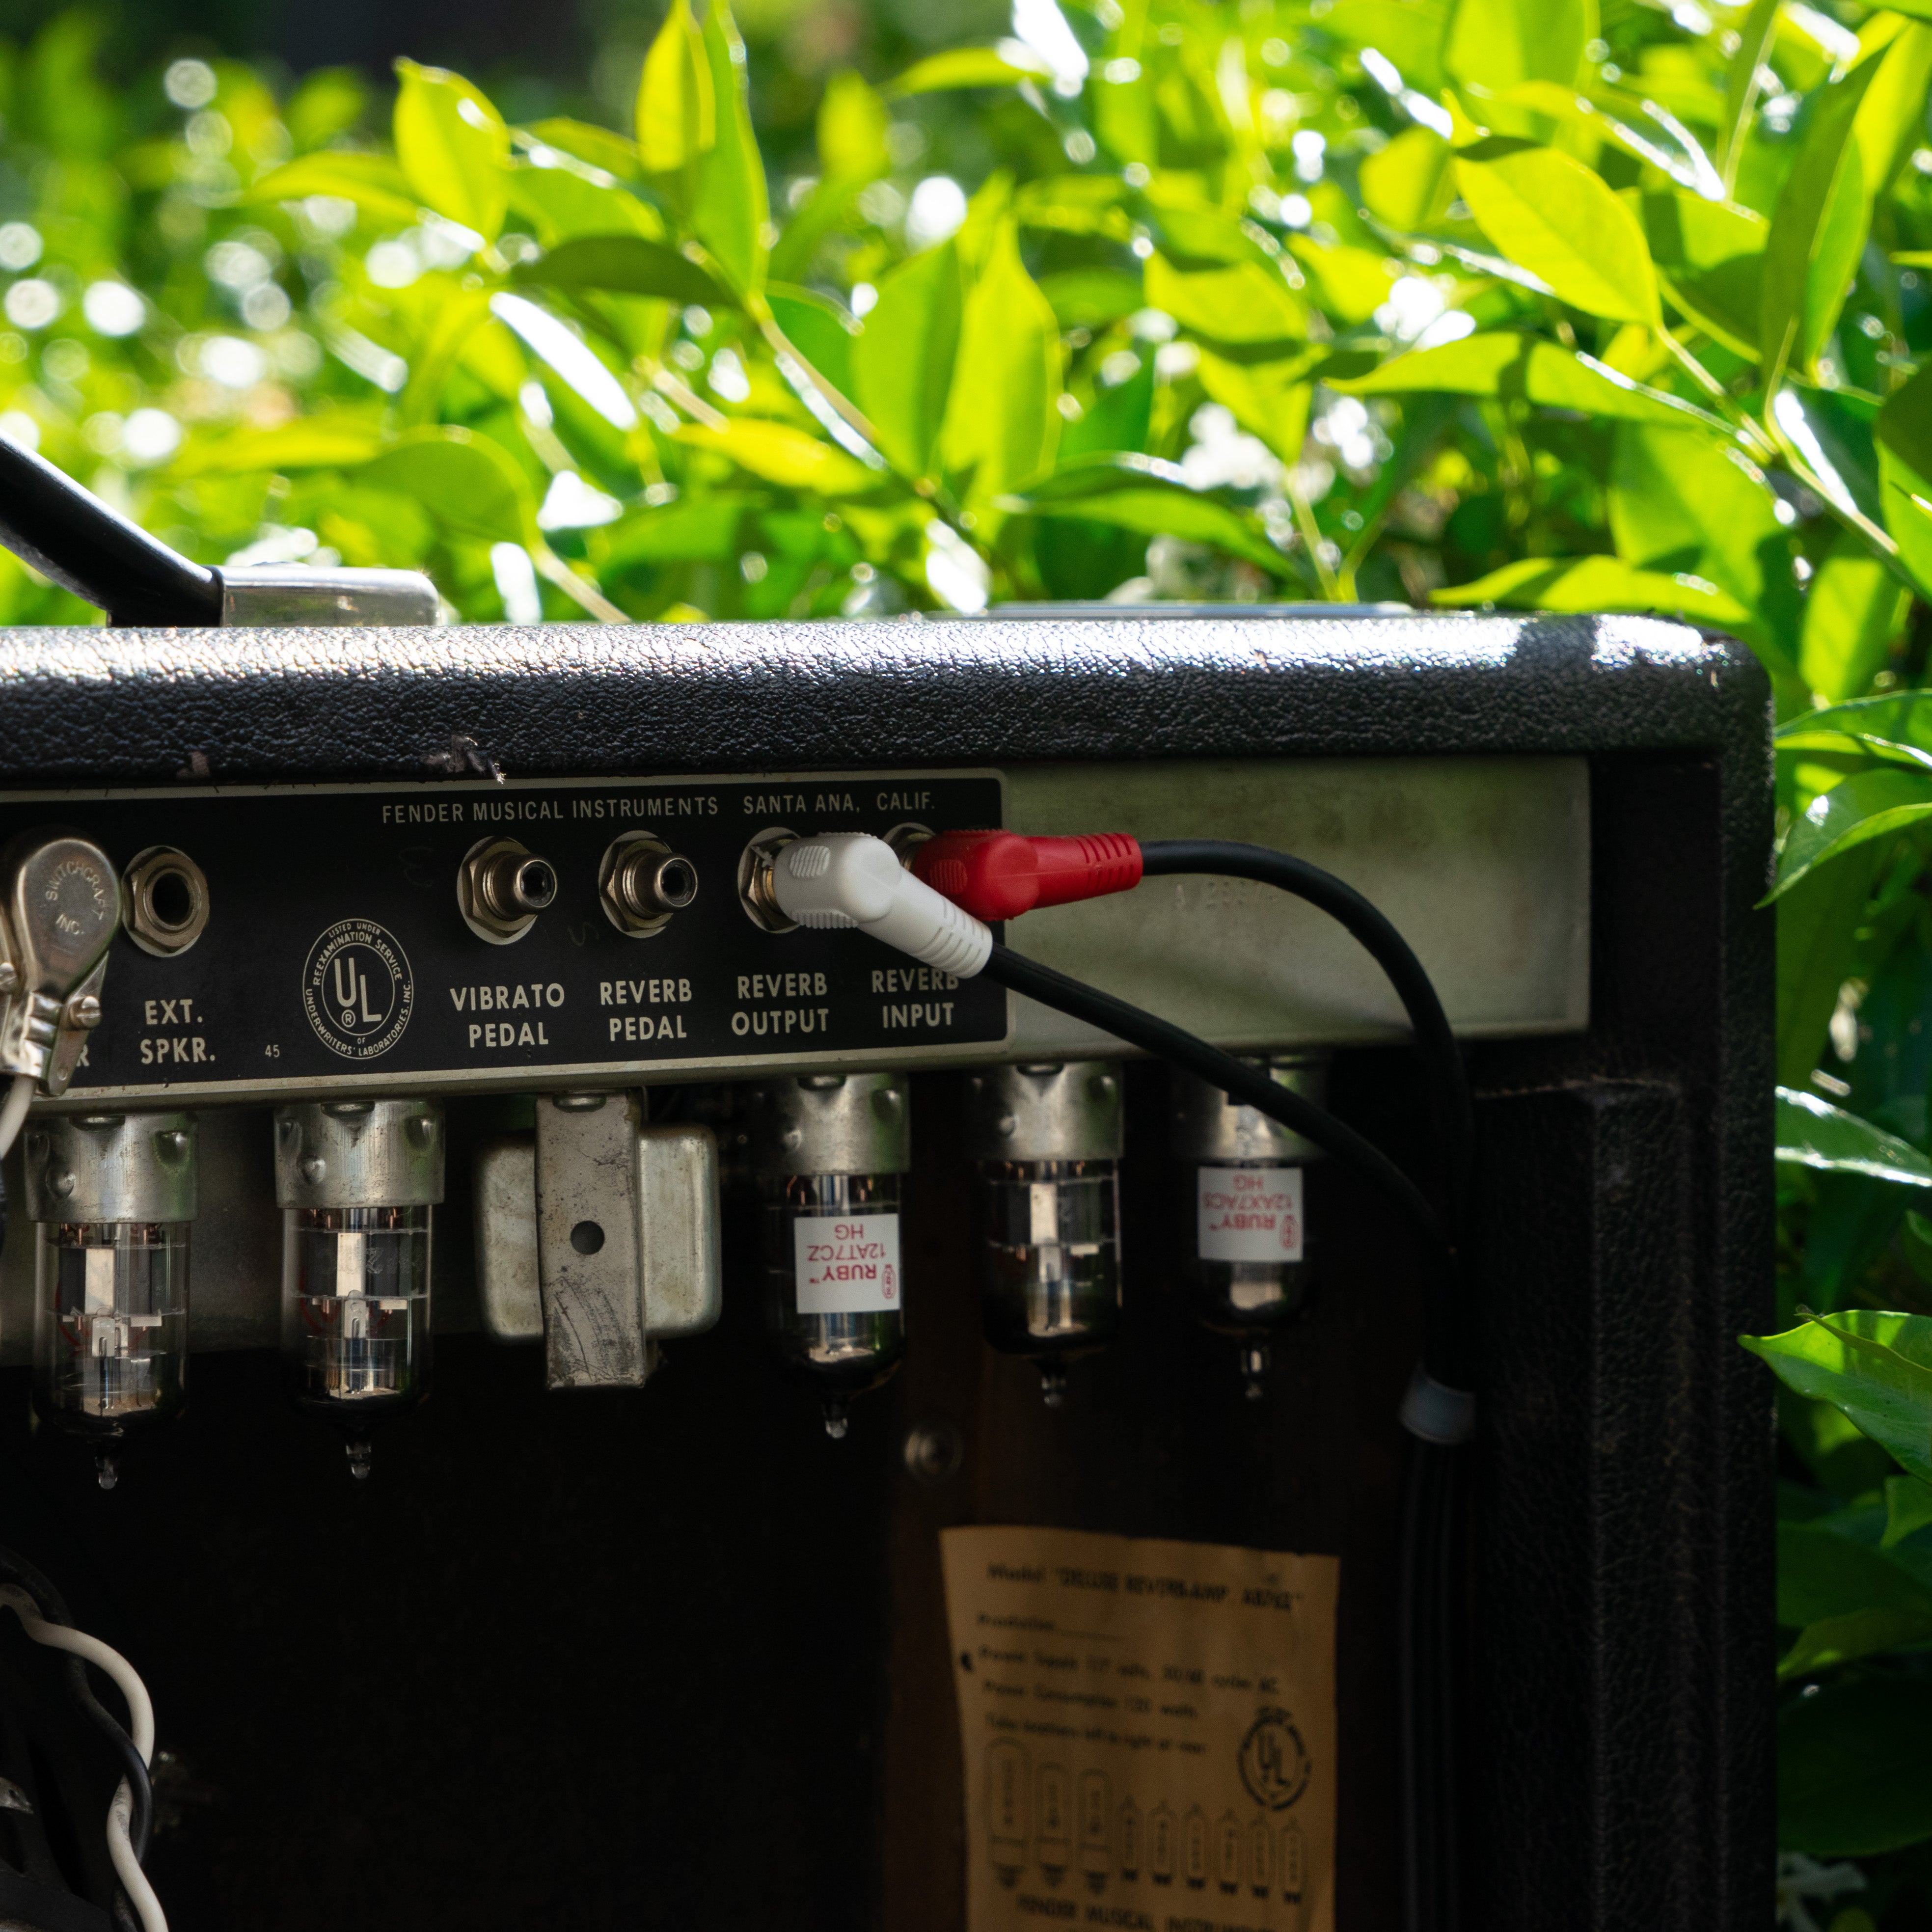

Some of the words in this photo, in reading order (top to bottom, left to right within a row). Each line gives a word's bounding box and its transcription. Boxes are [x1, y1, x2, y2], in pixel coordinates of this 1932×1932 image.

[382, 803, 463, 824] FENDER
[473, 801, 564, 821] MUSICAL
[572, 797, 718, 818] INSTRUMENTS
[743, 794, 806, 814] SANTA
[815, 794, 860, 812] ANA,
[876, 791, 935, 811] CALIF.
[46, 861, 106, 921] SWITCHCRAFT
[56, 914, 85, 935] INC.
[328, 923, 352, 938] LISTED
[356, 923, 381, 936] UNDER
[313, 932, 372, 985] REEXAMINATION
[375, 939, 402, 980] SERVICE
[334, 957, 381, 1022] UL
[403, 980, 411, 1003] INC.
[600, 979, 692, 1006] REVERB
[737, 973, 827, 999] REVERB
[871, 968, 958, 993] REVERB
[450, 982, 565, 1011] VIBRATO
[145, 999, 203, 1025] EXT.
[731, 1008, 829, 1036] OUTPUT
[883, 1002, 954, 1028] INPUT
[469, 1022, 549, 1048] PEDAL
[609, 1015, 687, 1042] PEDAL
[140, 1037, 216, 1064] SPKR.
[265, 1044, 280, 1058] 45
[834, 1223, 864, 1240] HG
[807, 1242, 886, 1262] 12AT7CZ
